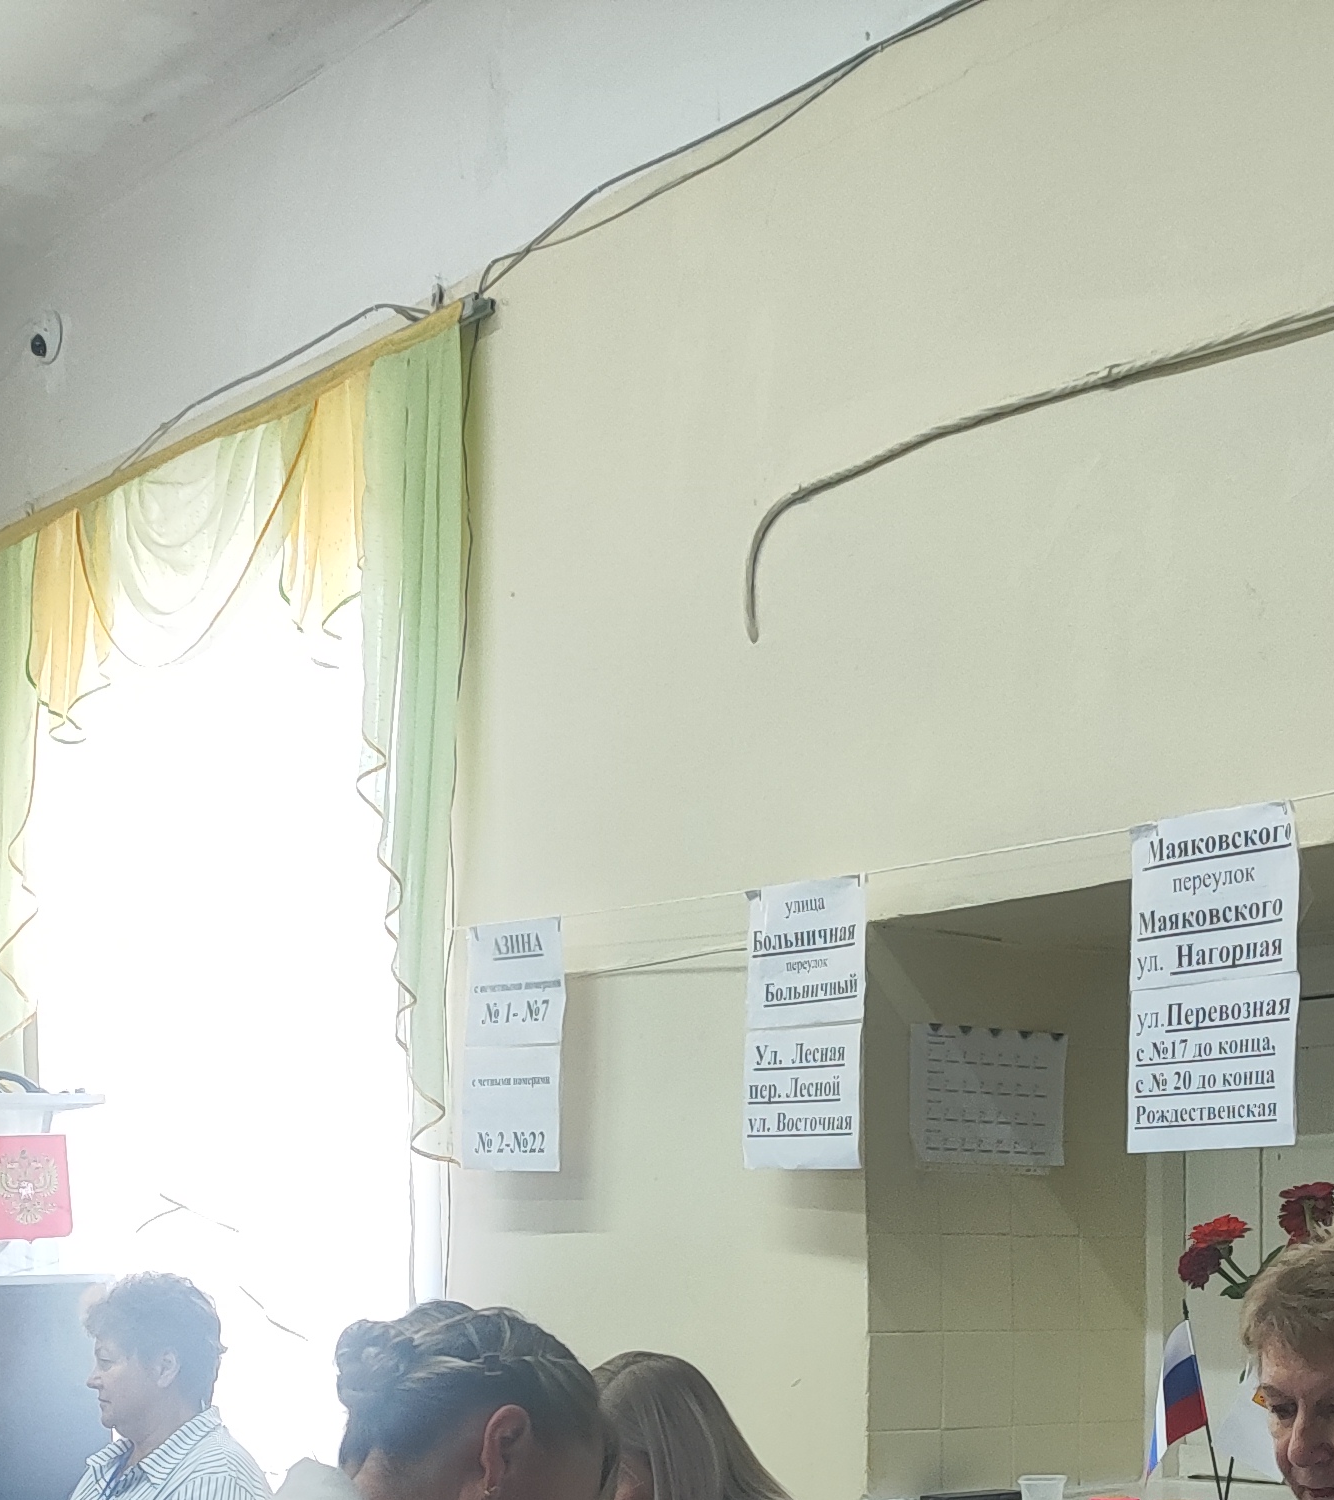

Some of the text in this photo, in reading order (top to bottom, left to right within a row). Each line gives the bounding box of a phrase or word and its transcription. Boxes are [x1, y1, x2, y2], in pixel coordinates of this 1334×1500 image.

[1147, 822, 1292, 865] Маяковского
[1172, 867, 1255, 896] переулок
[784, 897, 826, 919] улица
[1138, 898, 1284, 936] Маяковского
[492, 931, 544, 956] АЗИНА
[752, 923, 857, 953] Больничная
[785, 957, 829, 974] переулок
[1137, 938, 1283, 980] ул. Нагорная
[764, 972, 858, 1003] Больничный
[481, 1002, 500, 1025] №
[755, 1042, 846, 1066] Ул. Лесная
[1136, 1048, 1145, 1062] с
[1193, 1042, 1213, 1058] до
[748, 1075, 841, 1102] пер. Лесной
[1135, 1069, 1275, 1093] с № 20 до конца
[747, 1112, 854, 1134] ул. Восточная
[1135, 1102, 1278, 1126] Рождественская
[474, 1131, 493, 1154] №
